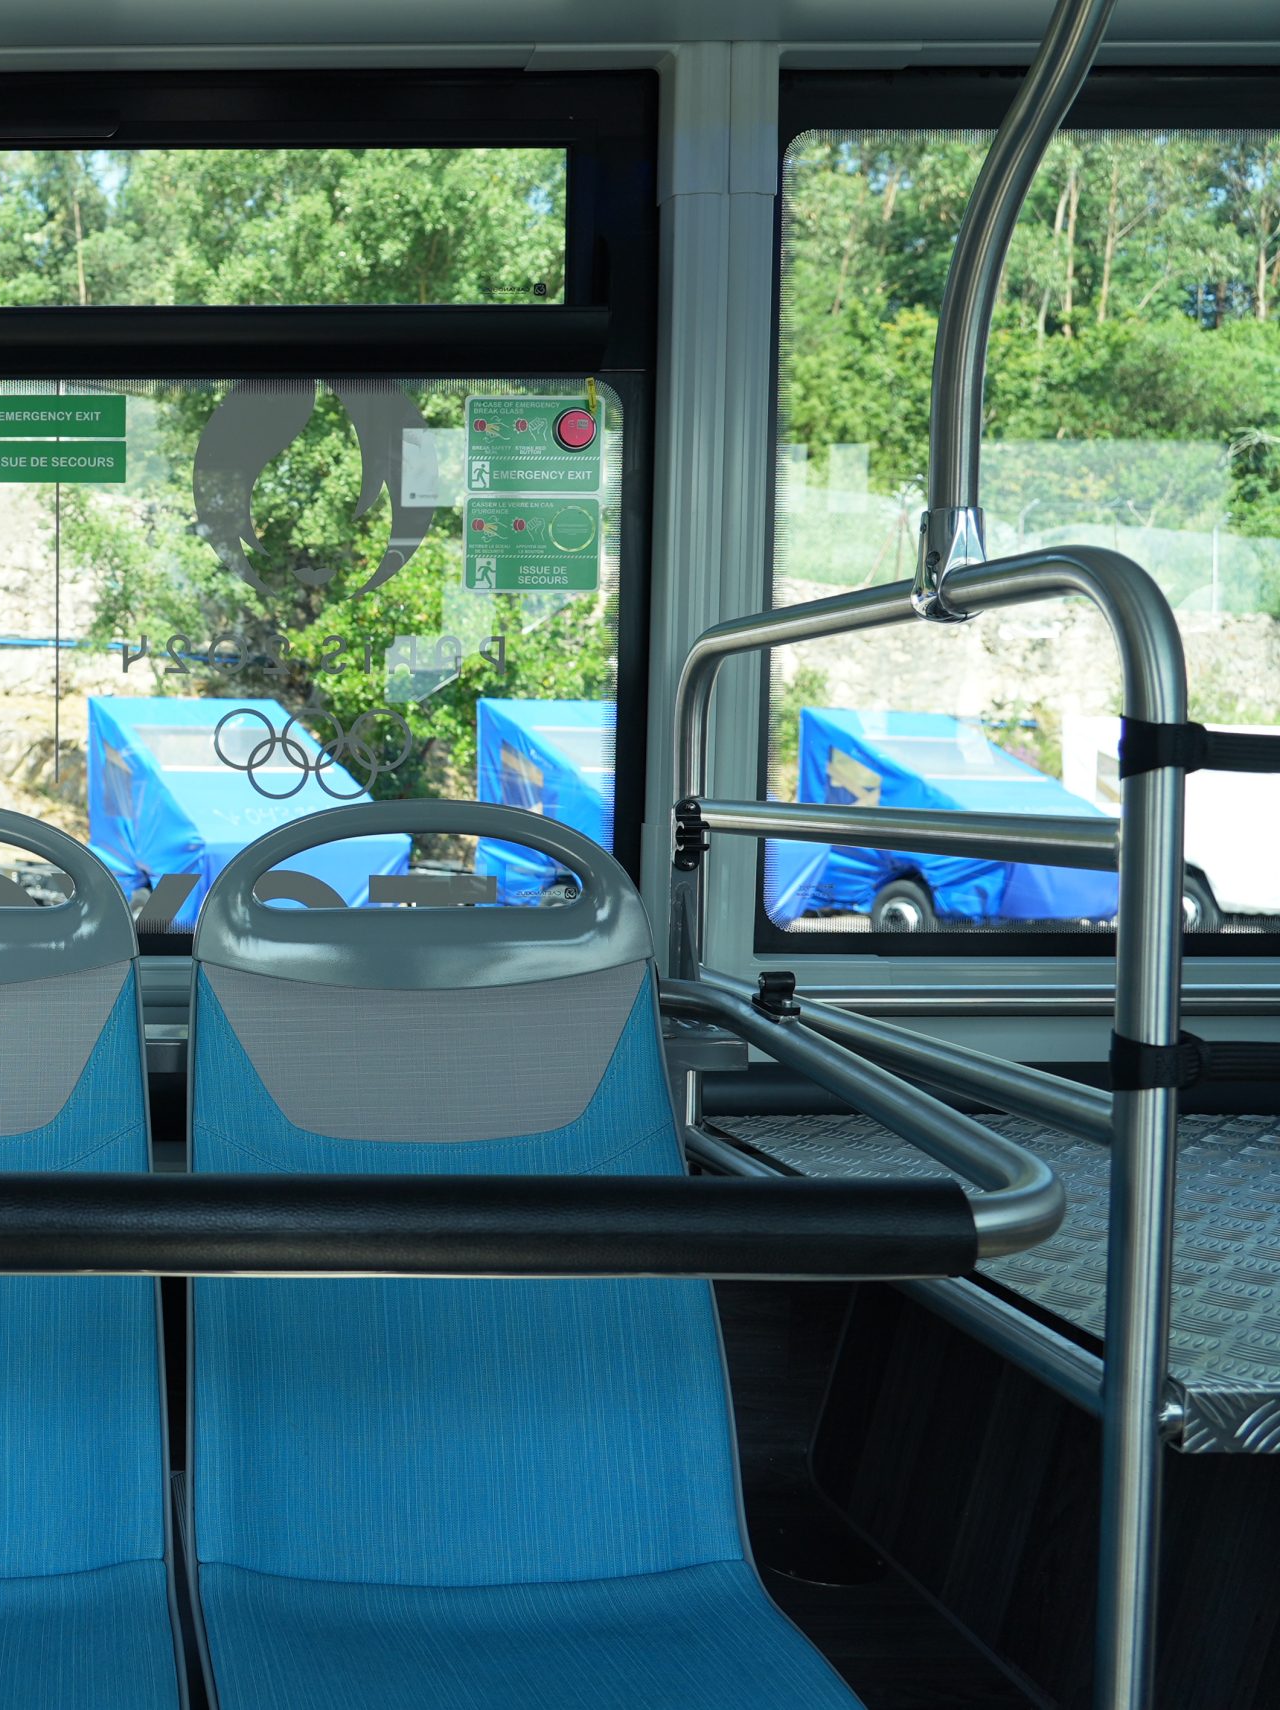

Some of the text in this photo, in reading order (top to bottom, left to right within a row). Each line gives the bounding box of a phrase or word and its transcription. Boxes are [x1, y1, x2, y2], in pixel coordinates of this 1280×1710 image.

[75, 411, 101, 421] EXIT
[30, 456, 48, 467] DE
[51, 456, 114, 468] SECOURS
[493, 470, 593, 480] EMERGENCY EXIT
[519, 566, 567, 575] ISSUE DE
[518, 576, 568, 585] SECOURS
